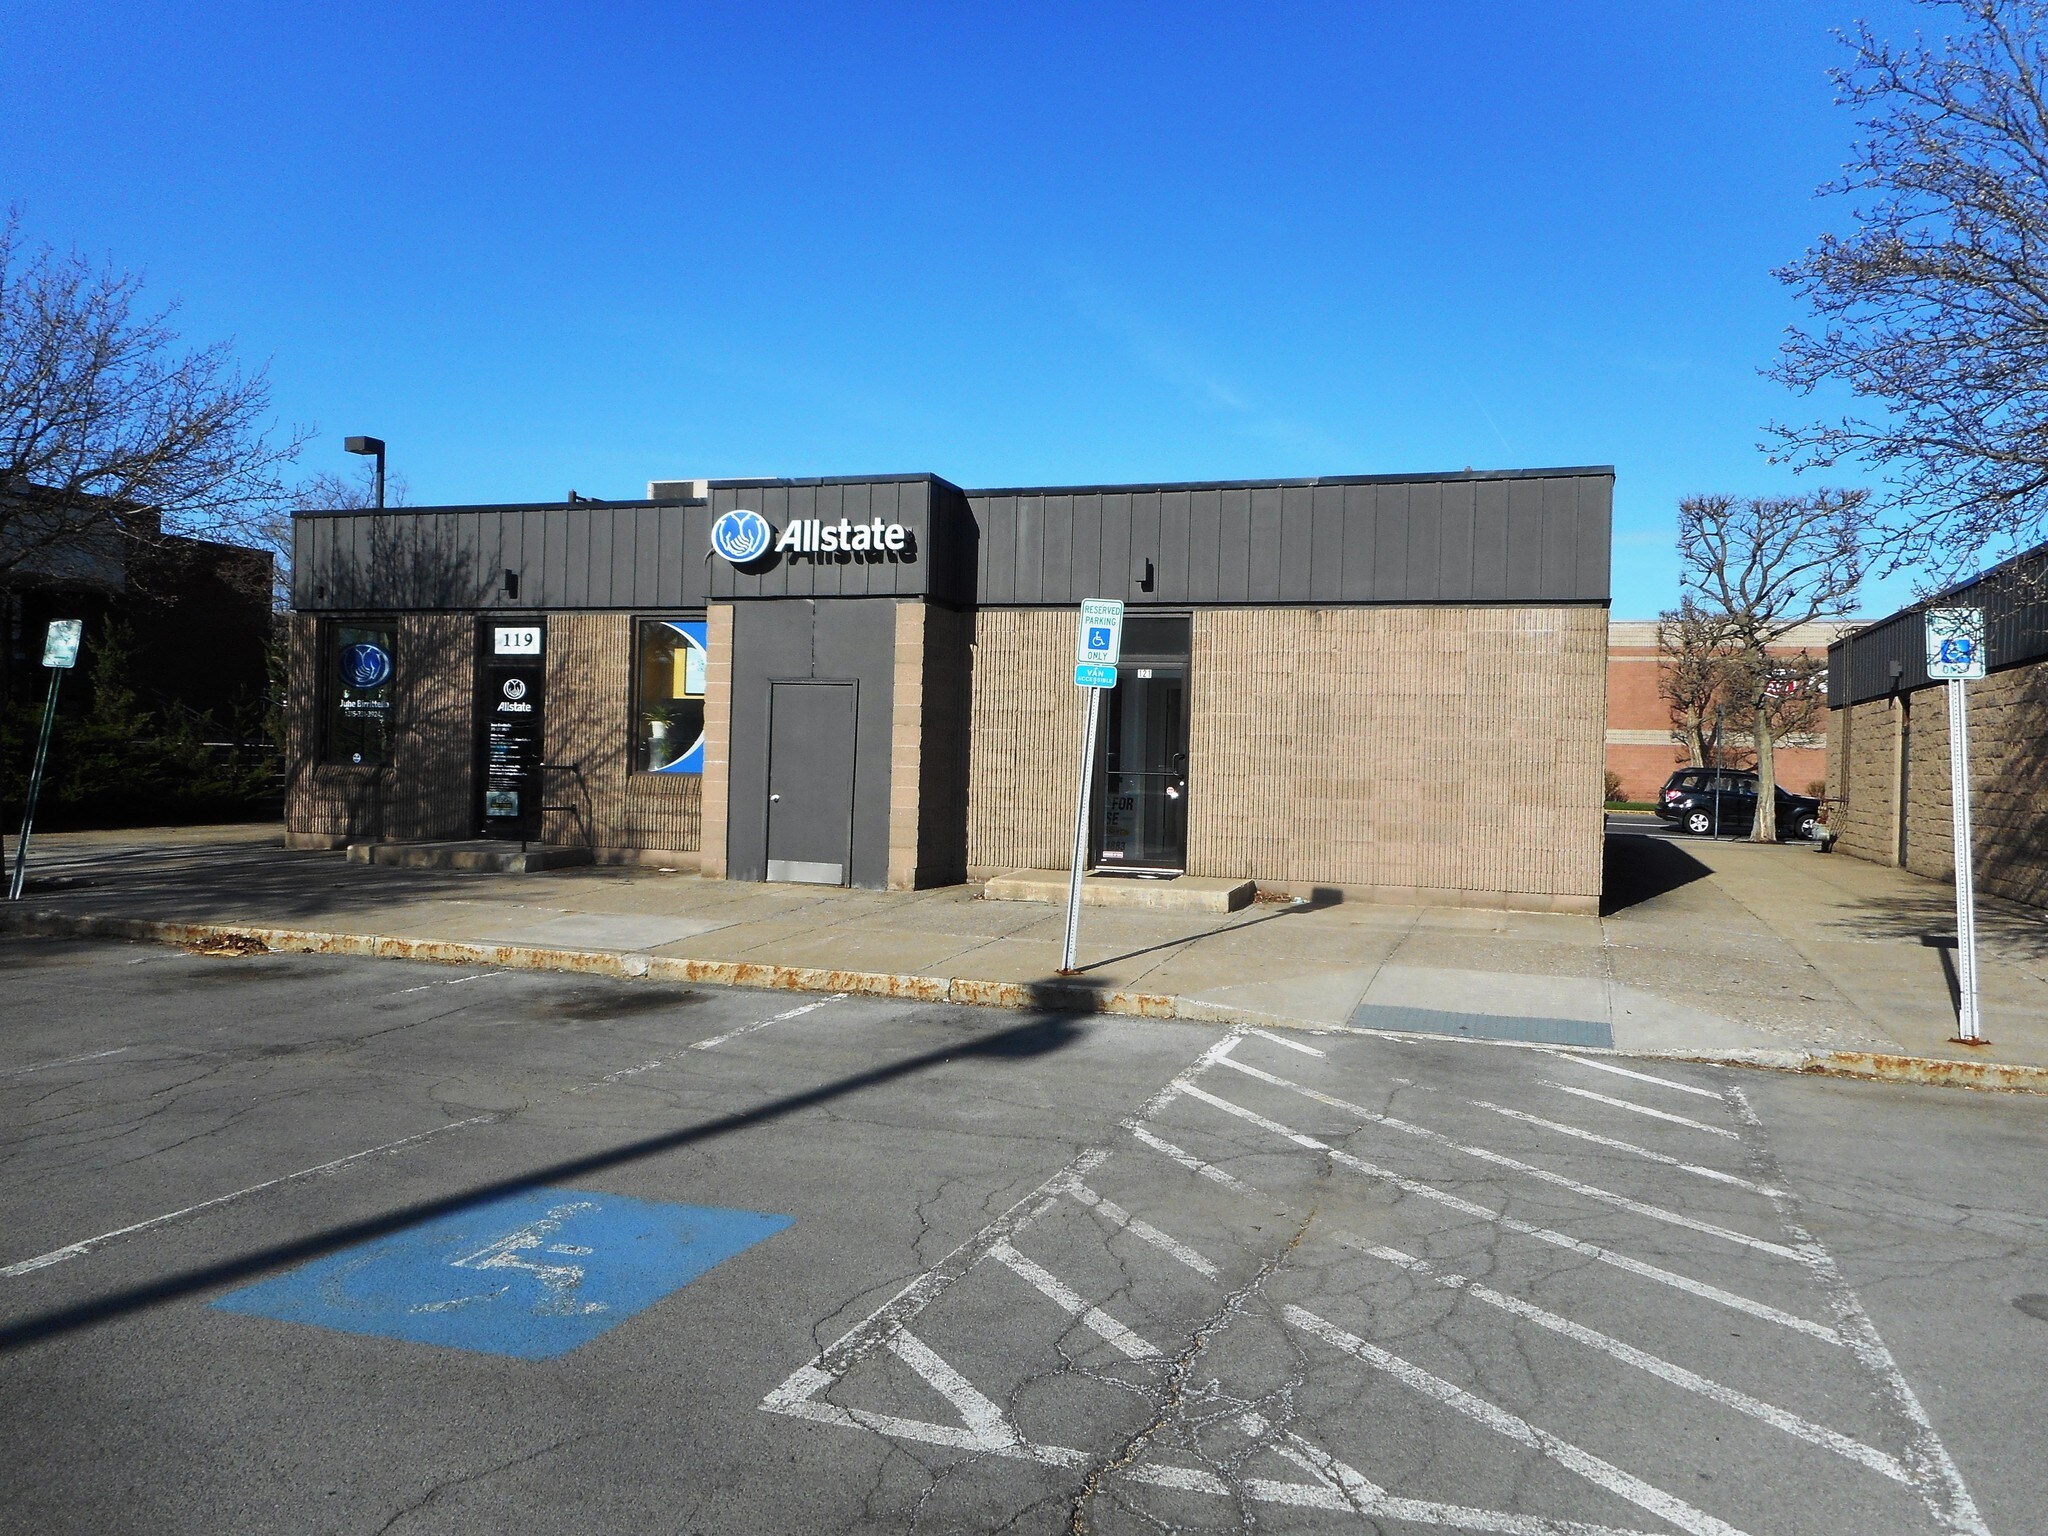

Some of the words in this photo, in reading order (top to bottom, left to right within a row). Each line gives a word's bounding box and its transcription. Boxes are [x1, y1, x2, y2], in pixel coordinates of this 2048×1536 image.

[775, 517, 905, 552] Allstate
[1085, 605, 1120, 616] RESERVED
[1085, 616, 1117, 626] PARKING
[503, 633, 533, 647] 119
[1088, 651, 1108, 661] ONLY
[1087, 669, 1104, 677] VAN
[1139, 669, 1151, 678] 121
[1077, 676, 1113, 684] ACCESSIBLE
[496, 701, 532, 712] Allstate
[1111, 797, 1134, 811] FOR
